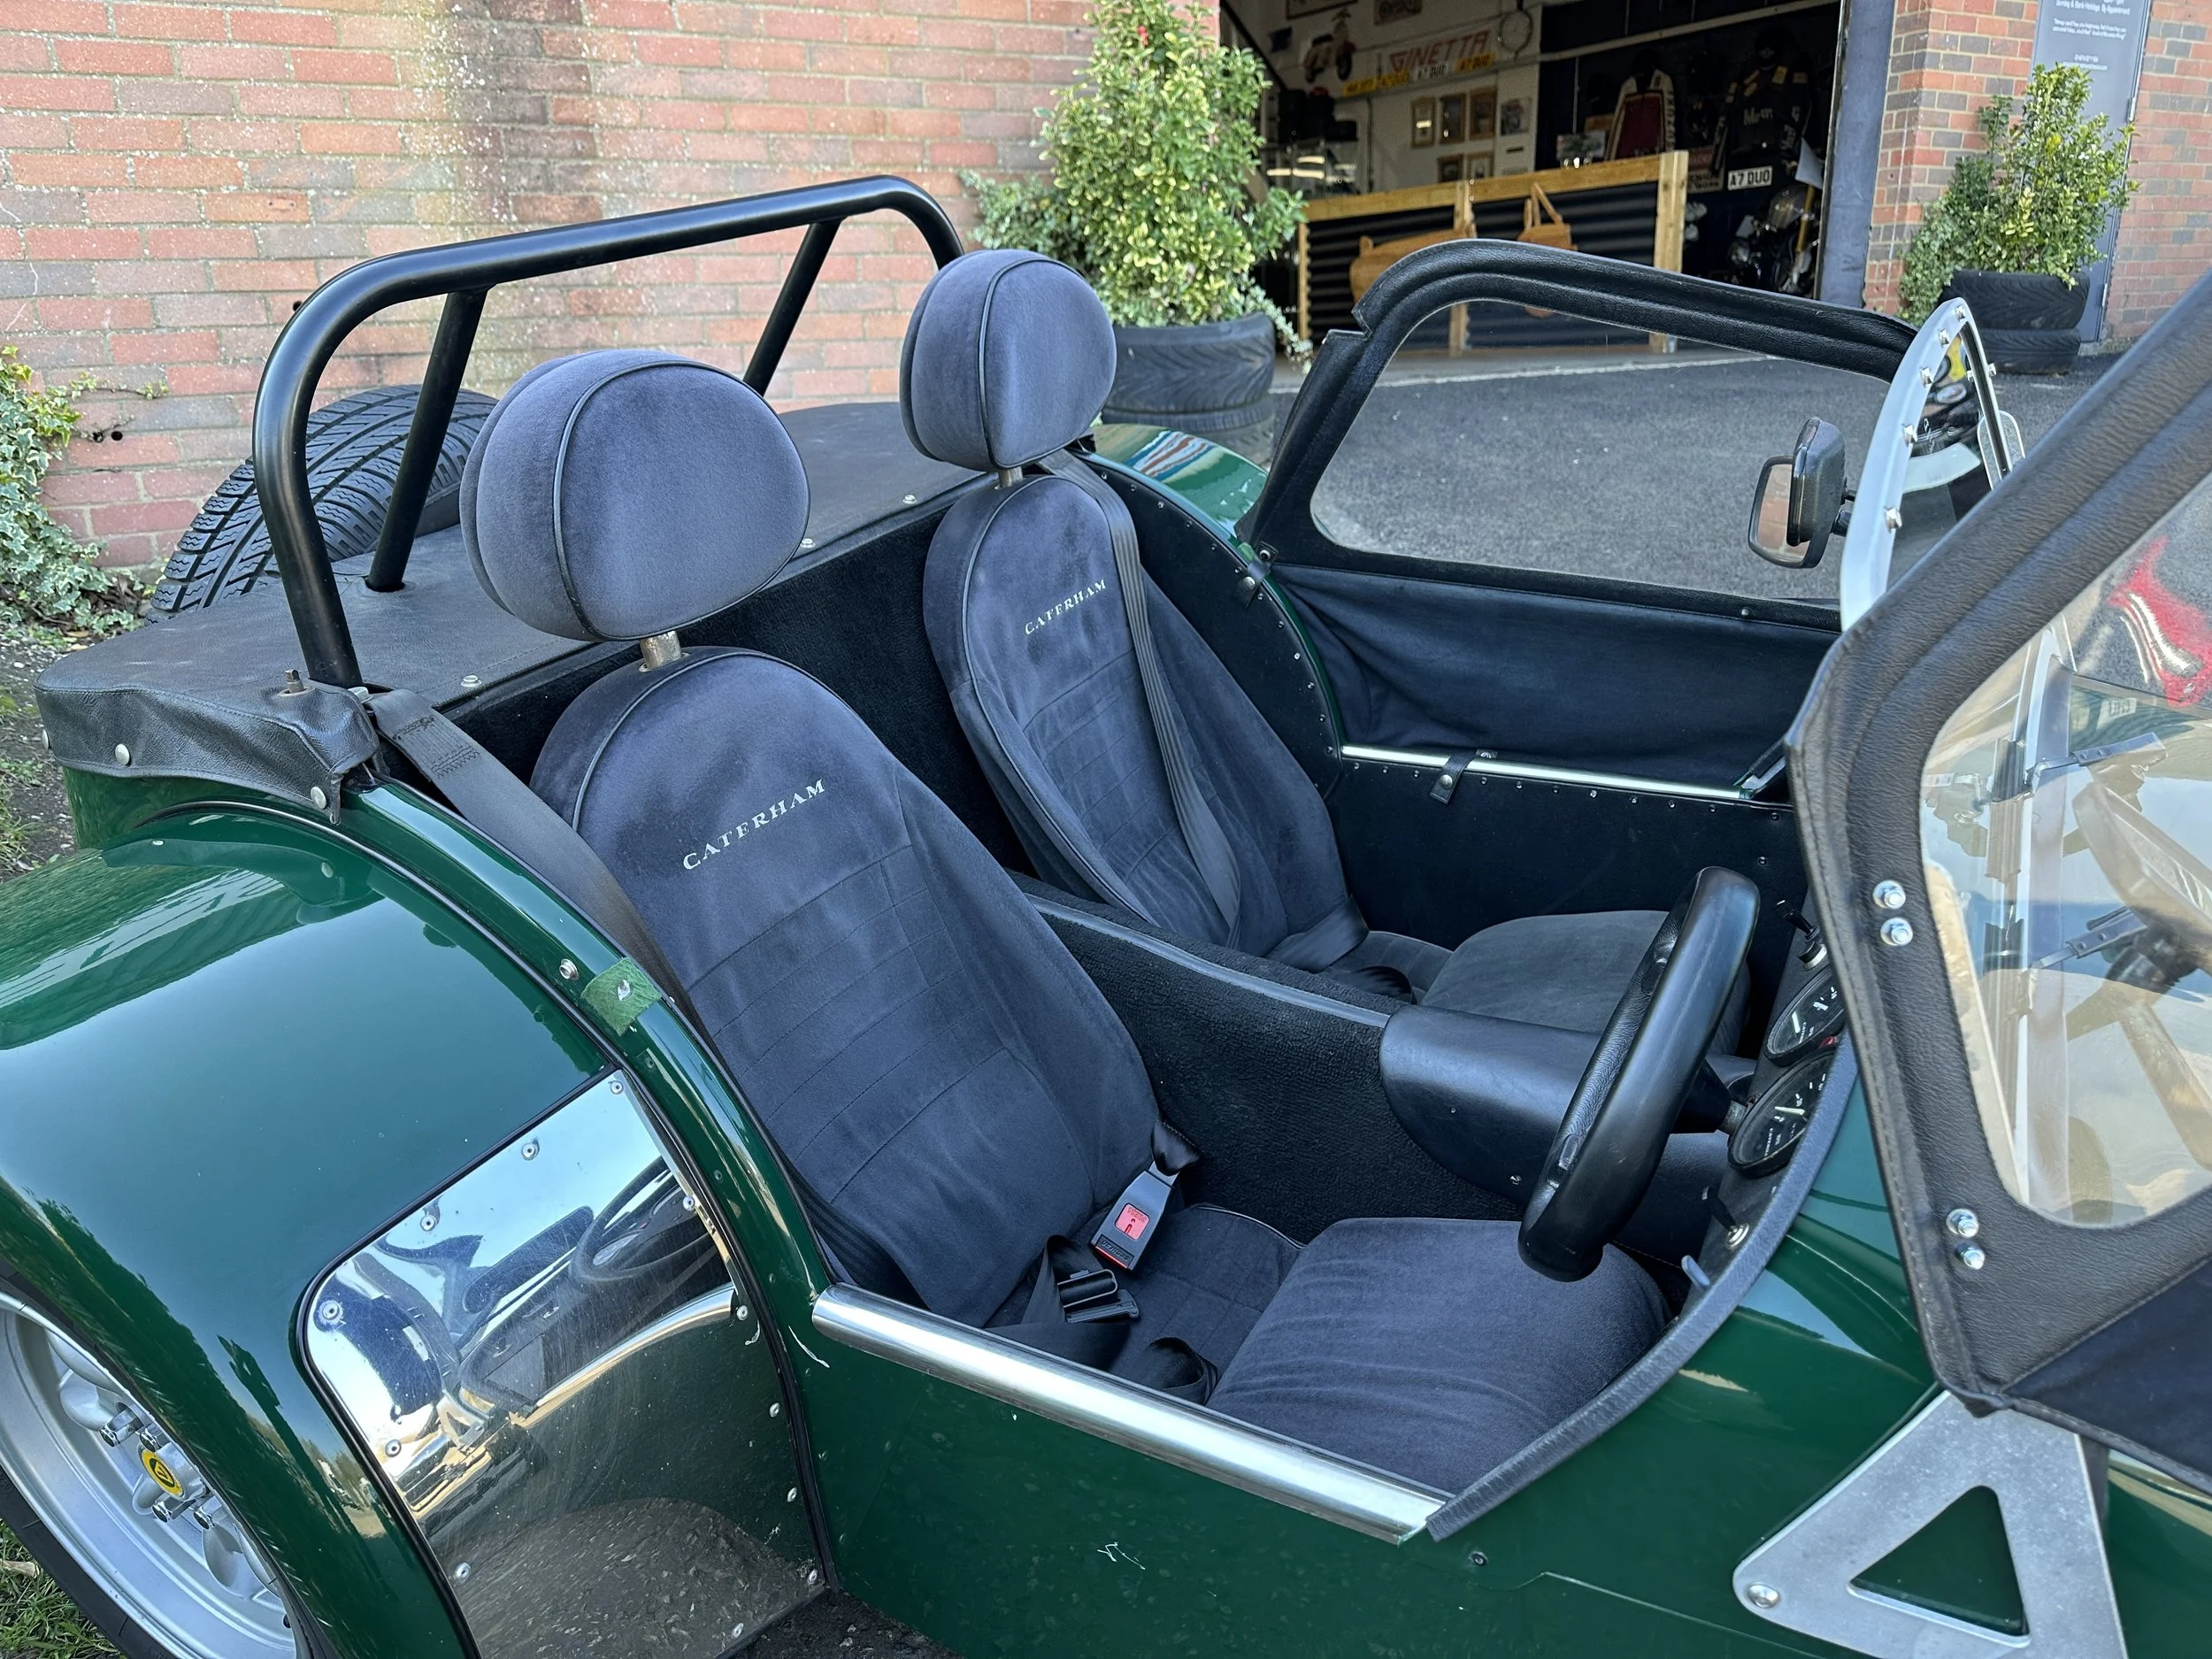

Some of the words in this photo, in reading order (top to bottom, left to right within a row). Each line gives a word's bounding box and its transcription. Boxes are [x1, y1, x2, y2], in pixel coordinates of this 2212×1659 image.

[1389, 29, 1492, 73] GINETTA
[1731, 172, 1745, 186] A7
[1747, 169, 1770, 185] DUO
[1025, 579, 1106, 635] CATERHAM
[682, 779, 826, 870] CATERHAM
